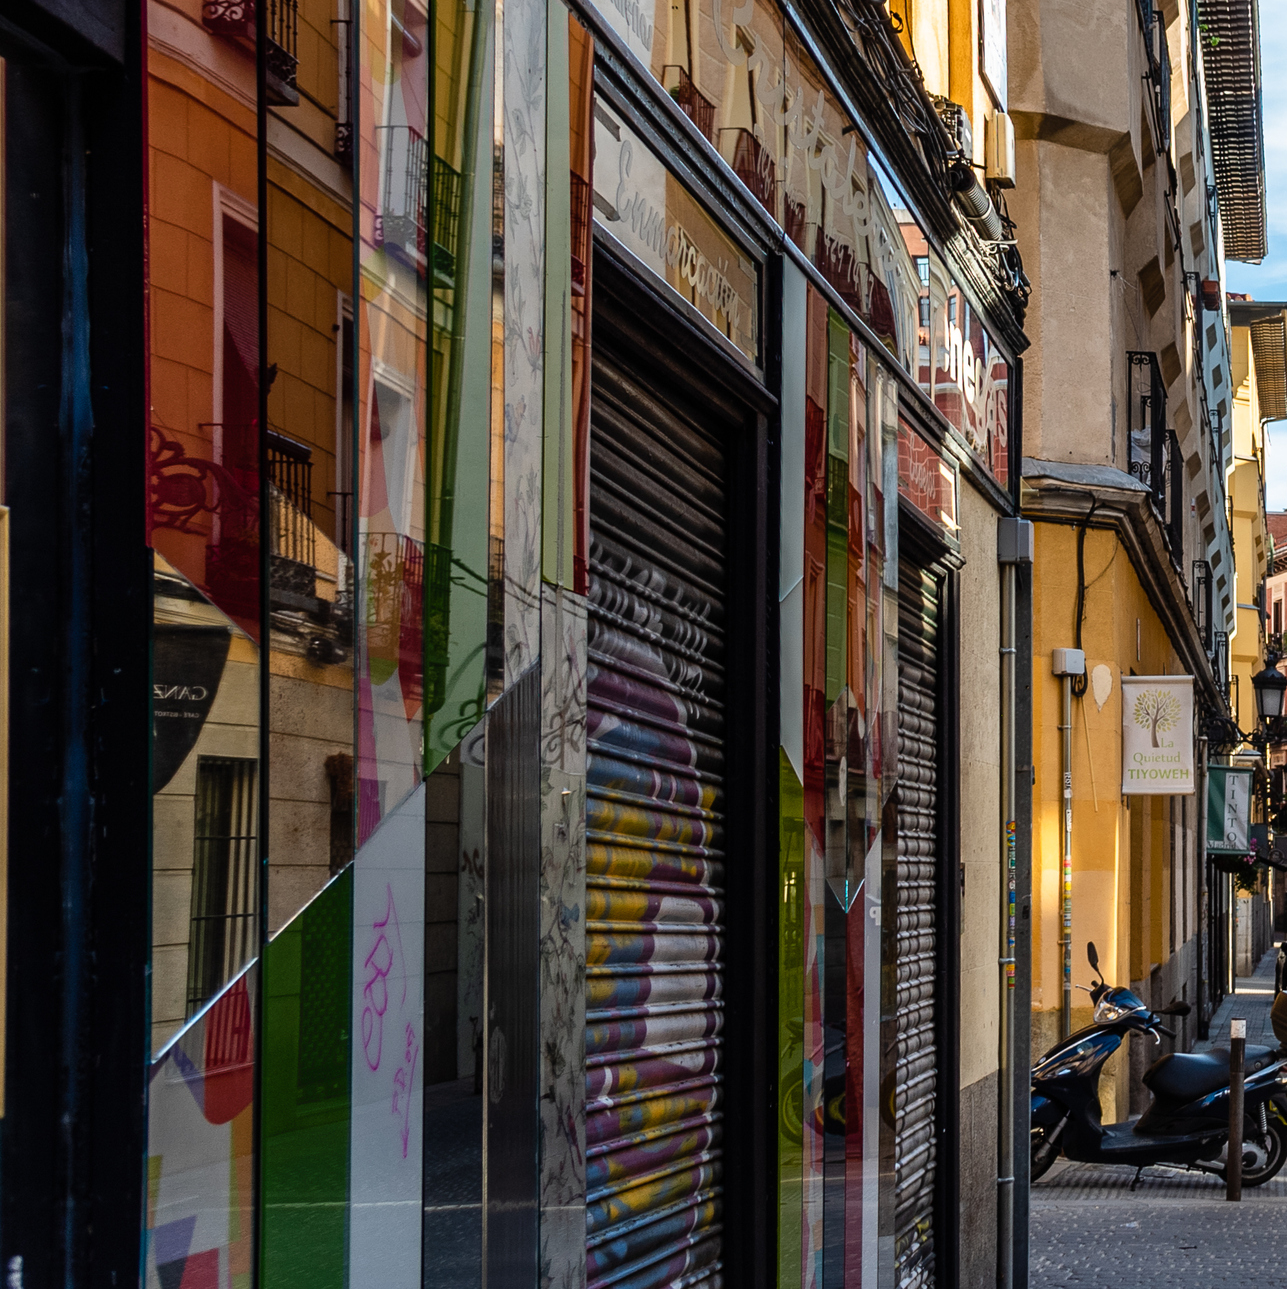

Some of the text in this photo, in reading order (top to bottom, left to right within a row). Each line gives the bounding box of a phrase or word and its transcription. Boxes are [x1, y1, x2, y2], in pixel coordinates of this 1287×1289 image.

[1160, 737, 1174, 748] La
[1133, 752, 1181, 766] Quietud
[1128, 768, 1189, 780] TIYOWEH
[1227, 775, 1239, 841] TINTO
